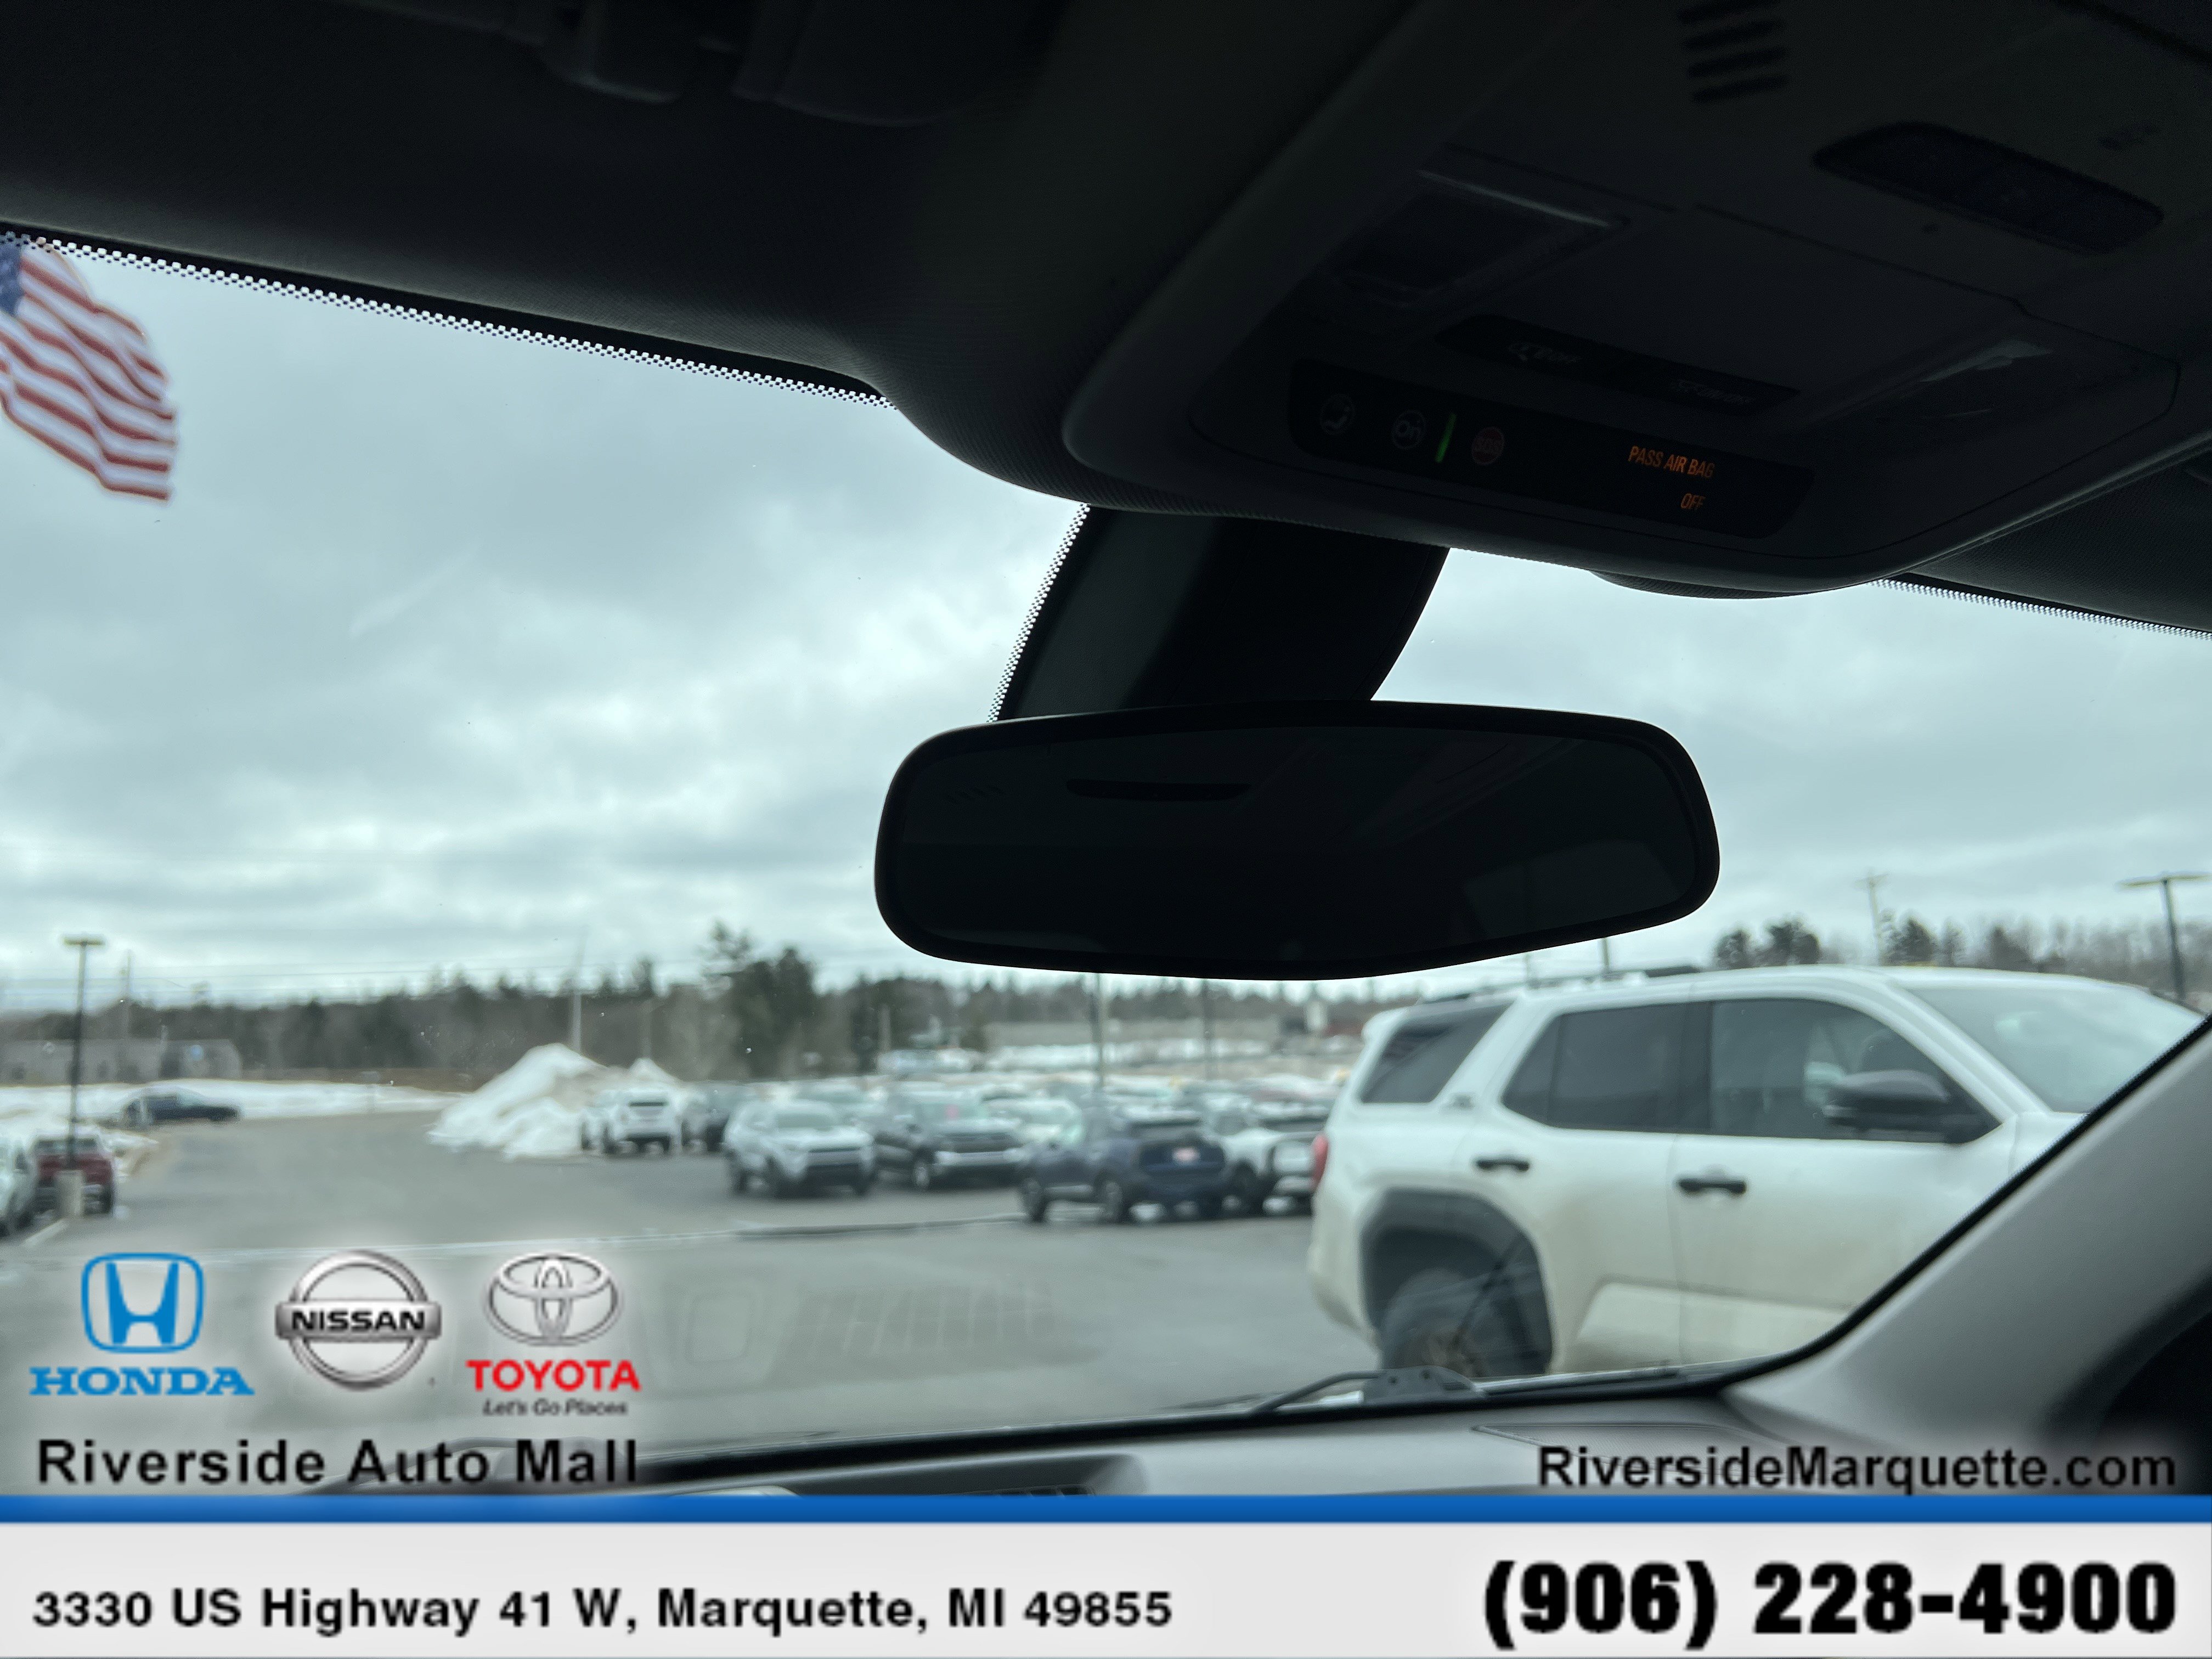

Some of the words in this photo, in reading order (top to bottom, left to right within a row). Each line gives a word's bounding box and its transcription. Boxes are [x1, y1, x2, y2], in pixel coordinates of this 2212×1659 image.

[1627, 444, 1664, 470] PASS
[1663, 454, 1689, 474] AIR
[1686, 457, 1717, 480] BAG
[1679, 492, 1706, 510] OFF
